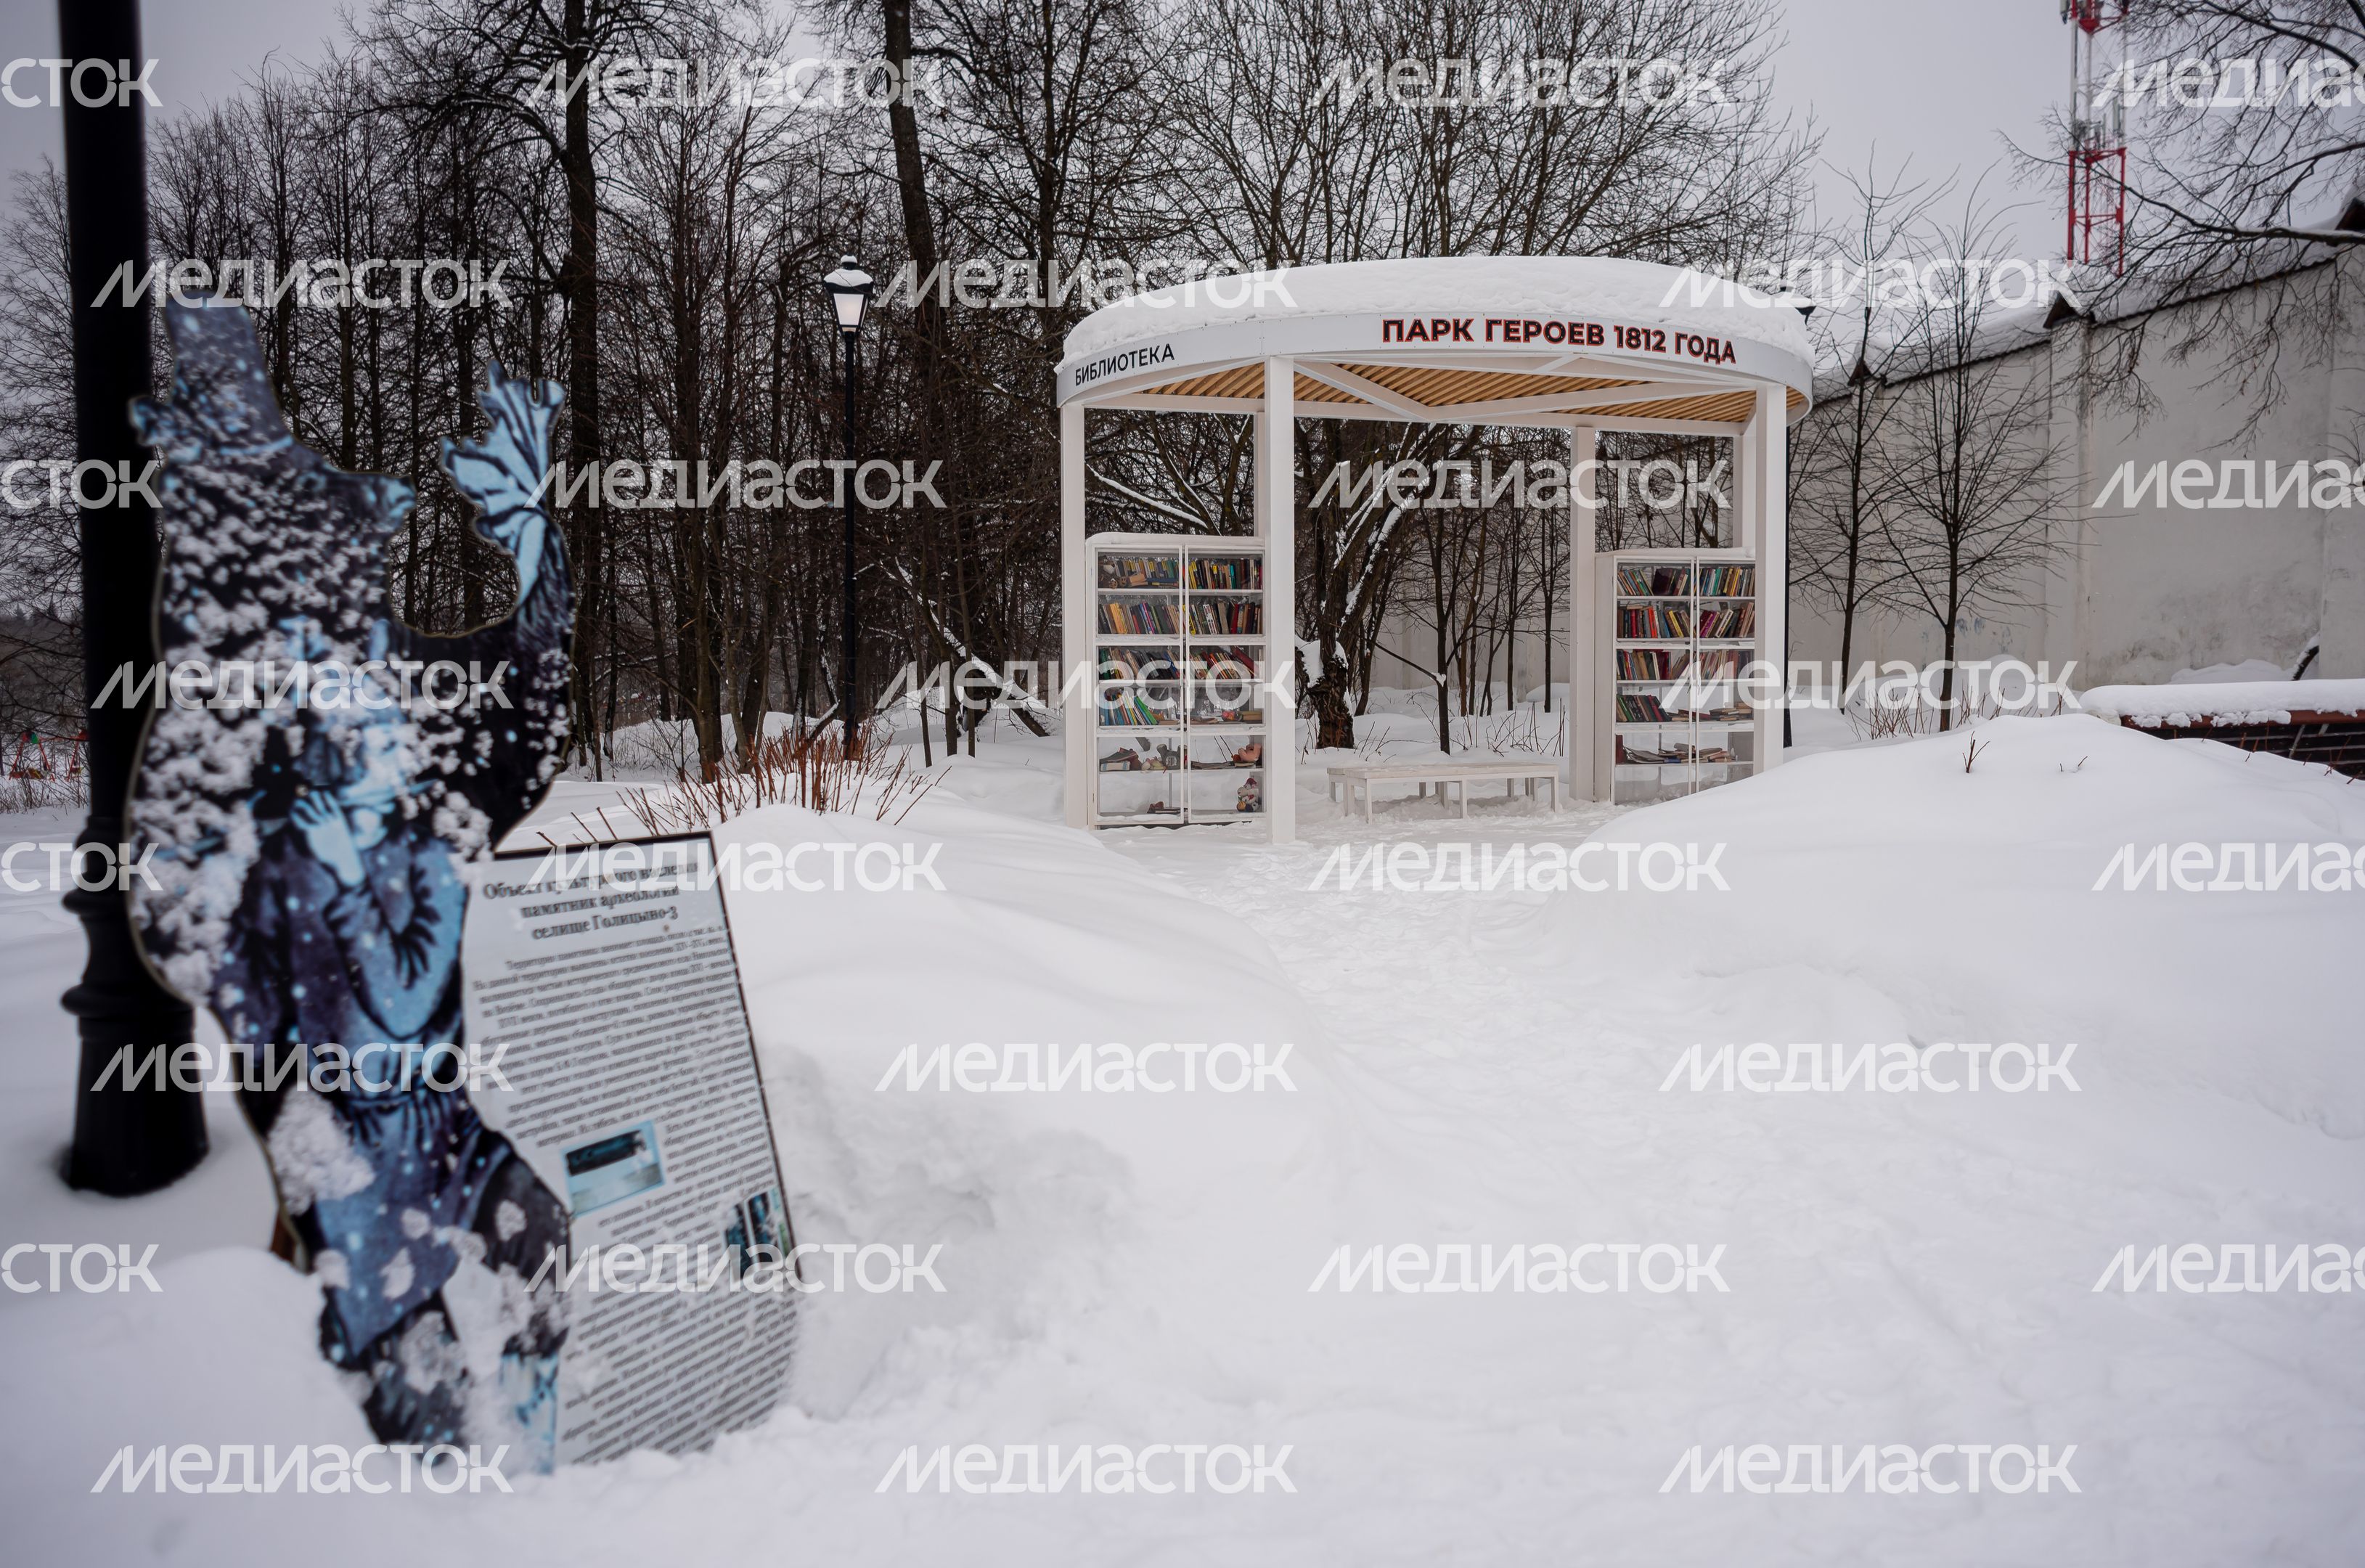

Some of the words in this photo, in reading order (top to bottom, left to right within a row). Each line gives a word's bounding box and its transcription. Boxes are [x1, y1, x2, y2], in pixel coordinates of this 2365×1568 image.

[1381, 318, 1475, 343] ПАРК
[1484, 319, 1605, 347] ГЕРОЕВ
[1613, 324, 1667, 353] 1812
[1675, 332, 1736, 365] ГОДА
[1075, 343, 1175, 386] БИБЛИОТЕКА
[483, 880, 542, 899] Объект
[520, 899, 597, 918] памятник
[531, 918, 591, 940] селище
